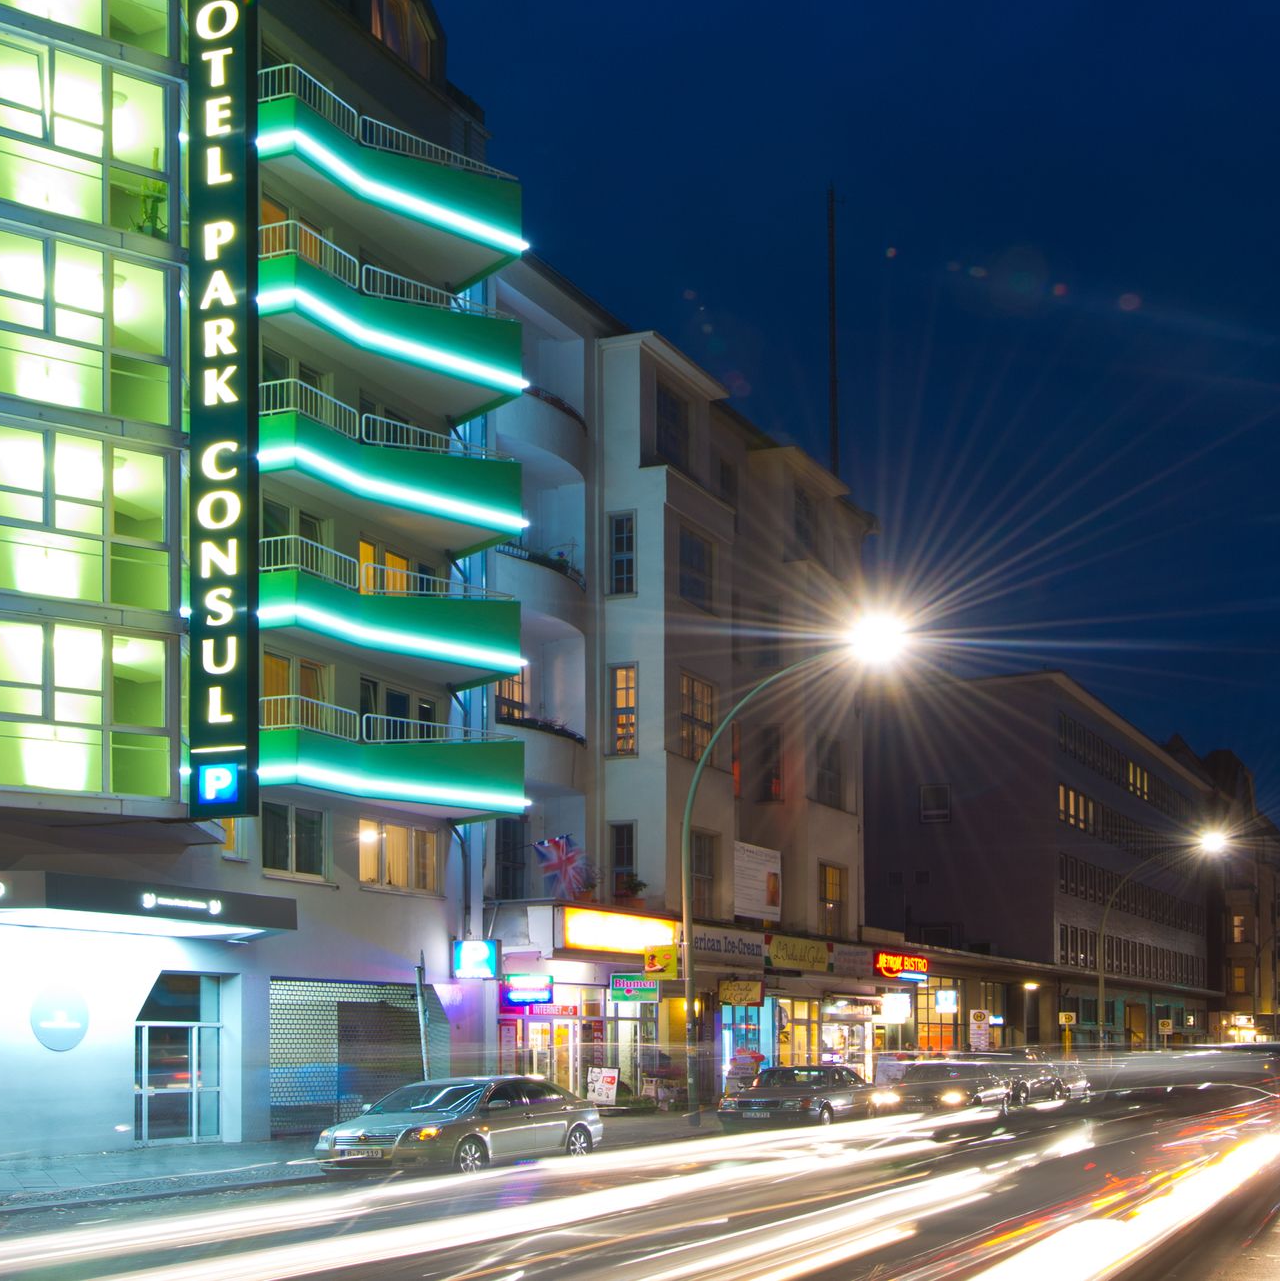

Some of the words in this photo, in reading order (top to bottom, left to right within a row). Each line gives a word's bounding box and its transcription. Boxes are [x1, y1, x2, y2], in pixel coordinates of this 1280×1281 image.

[200, 219, 239, 407] PARK
[196, 440, 241, 725] CONSUL
[903, 956, 928, 972] BISTRO
[614, 978, 656, 989] Blumen
[532, 1005, 562, 1015] INTERNET
